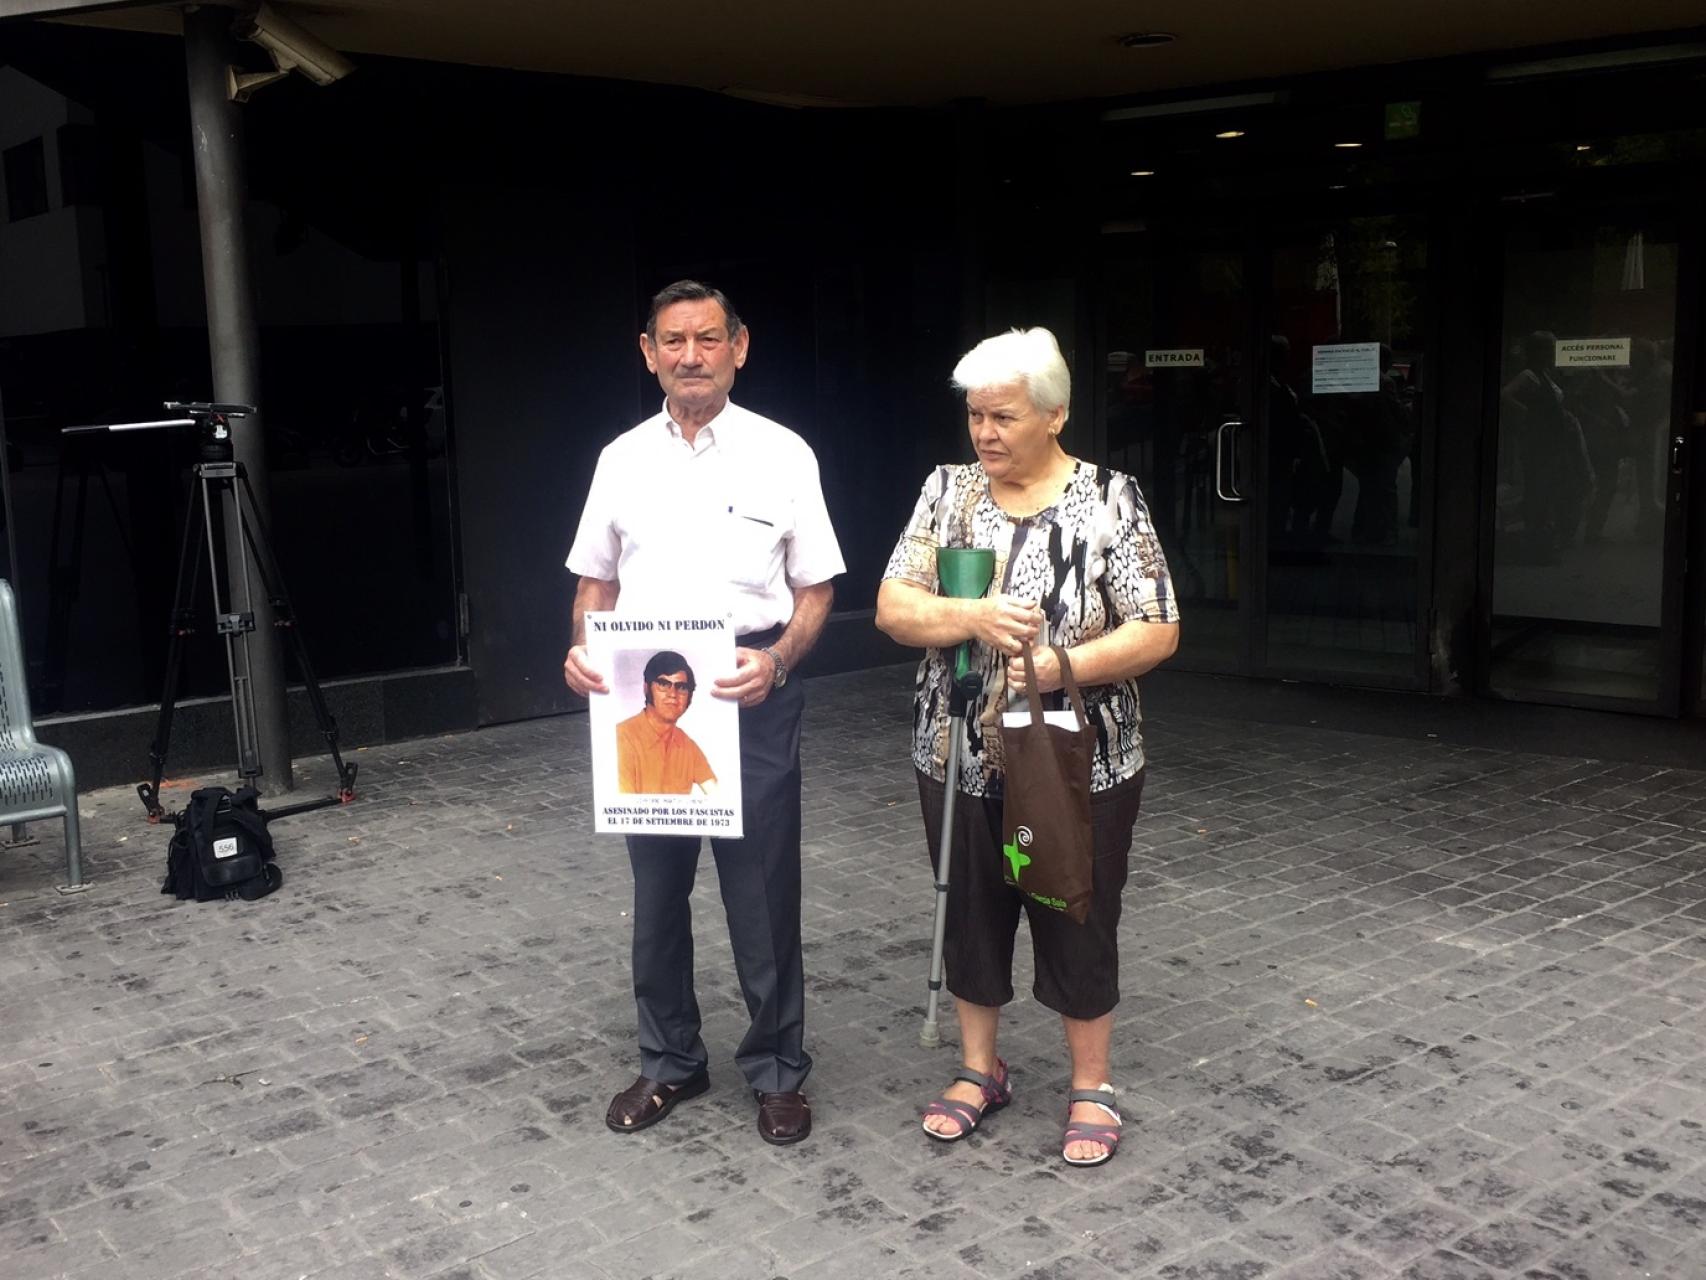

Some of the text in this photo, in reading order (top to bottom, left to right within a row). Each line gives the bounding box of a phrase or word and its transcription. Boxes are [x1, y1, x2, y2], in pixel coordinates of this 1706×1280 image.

[1148, 353, 1200, 363] ENTRADA
[593, 619, 725, 632] NI OLVIDO NI PERDON
[602, 807, 735, 817] ASESINADO POR LOS FASCISTAS
[608, 817, 618, 825] EL
[632, 817, 644, 825] DE
[646, 817, 693, 826] SETIEMBRE
[696, 818, 708, 826] DE
